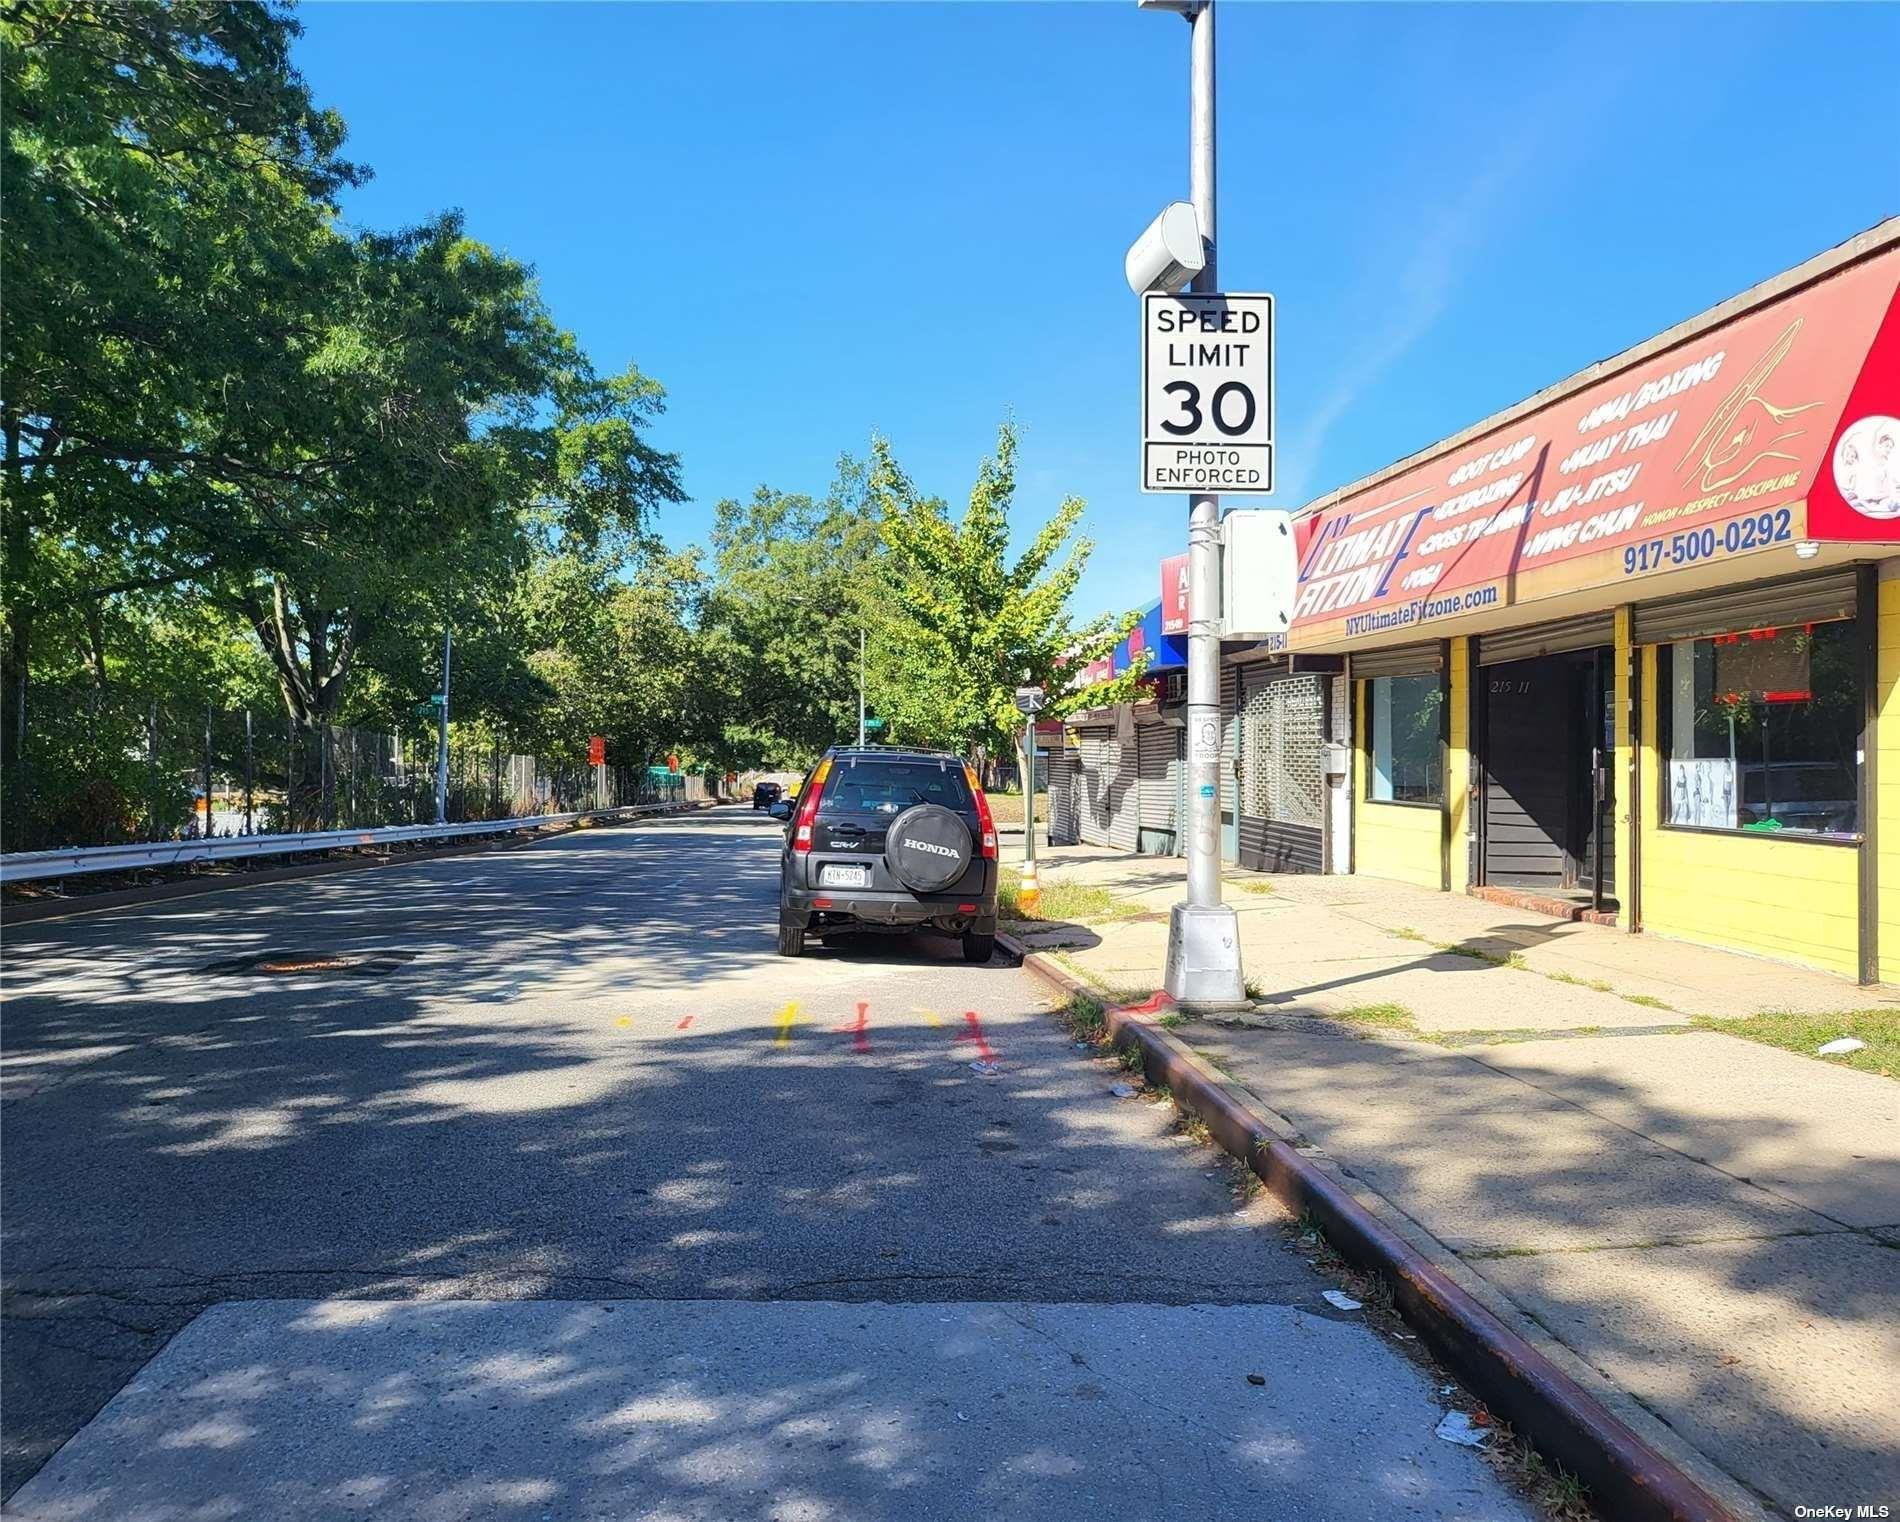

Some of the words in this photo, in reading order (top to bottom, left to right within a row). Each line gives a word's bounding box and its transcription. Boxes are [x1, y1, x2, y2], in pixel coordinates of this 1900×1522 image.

[1157, 309, 1260, 334] SPEED
[1169, 343, 1250, 367] LIMIT
[1160, 380, 1256, 437] 30
[1176, 450, 1240, 465] PHOTO
[1563, 430, 1627, 474] MUAY
[1620, 408, 1679, 454] THAI
[1155, 467, 1260, 484] ENFORCED
[1544, 462, 1643, 517] JIU-JITSU
[1640, 505, 1677, 528] HONOR
[1682, 491, 1729, 517] RESPECT
[1735, 470, 1801, 503] DISCIPLINE
[1526, 520, 1582, 558] WING
[1578, 501, 1645, 543] CHUN
[1623, 508, 1792, 575] 917-500-0292
[1345, 585, 1498, 637] NYUltimateFitzone.com
[1490, 680, 1512, 693] 215
[829, 840, 860, 849] CR-V
[903, 838, 961, 859] HONDA
